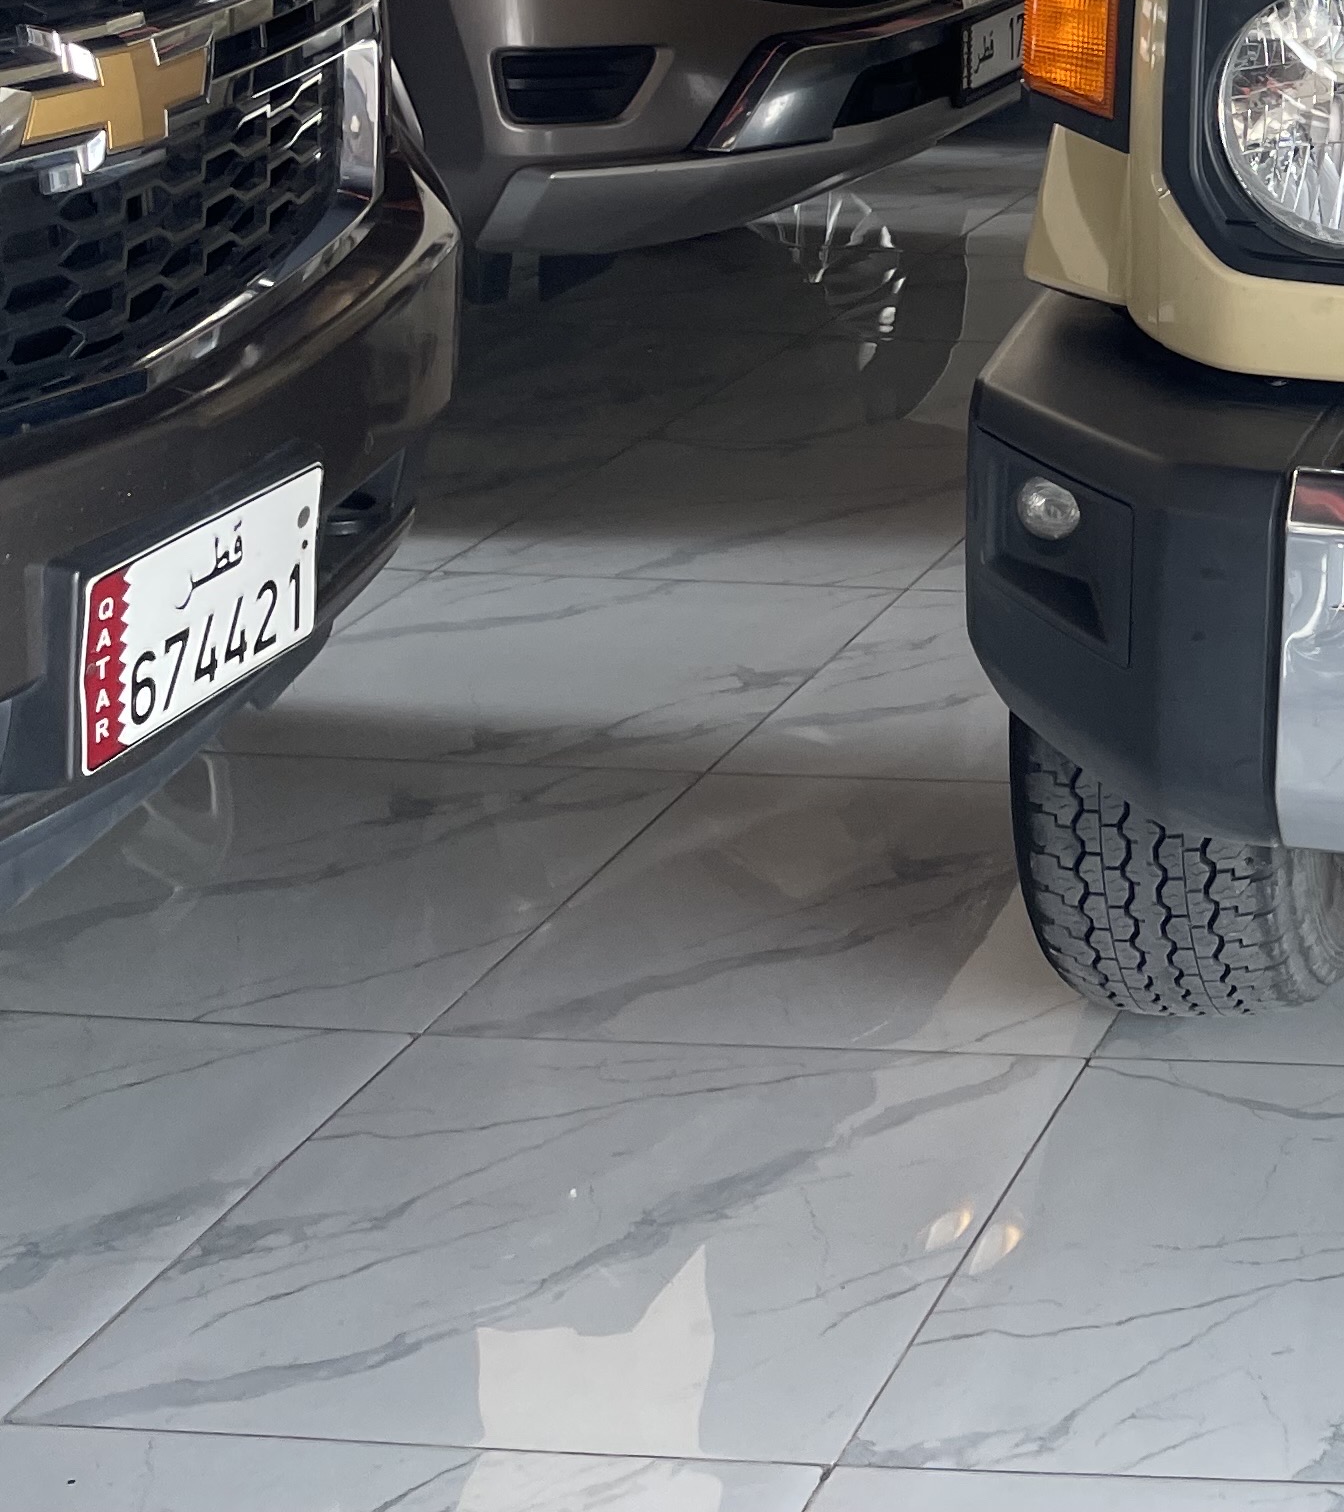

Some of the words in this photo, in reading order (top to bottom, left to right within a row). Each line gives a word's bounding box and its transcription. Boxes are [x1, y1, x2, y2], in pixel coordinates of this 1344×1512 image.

[174, 519, 245, 610] قطر
[94, 595, 115, 744] QATAR
[130, 562, 301, 726] 674421
